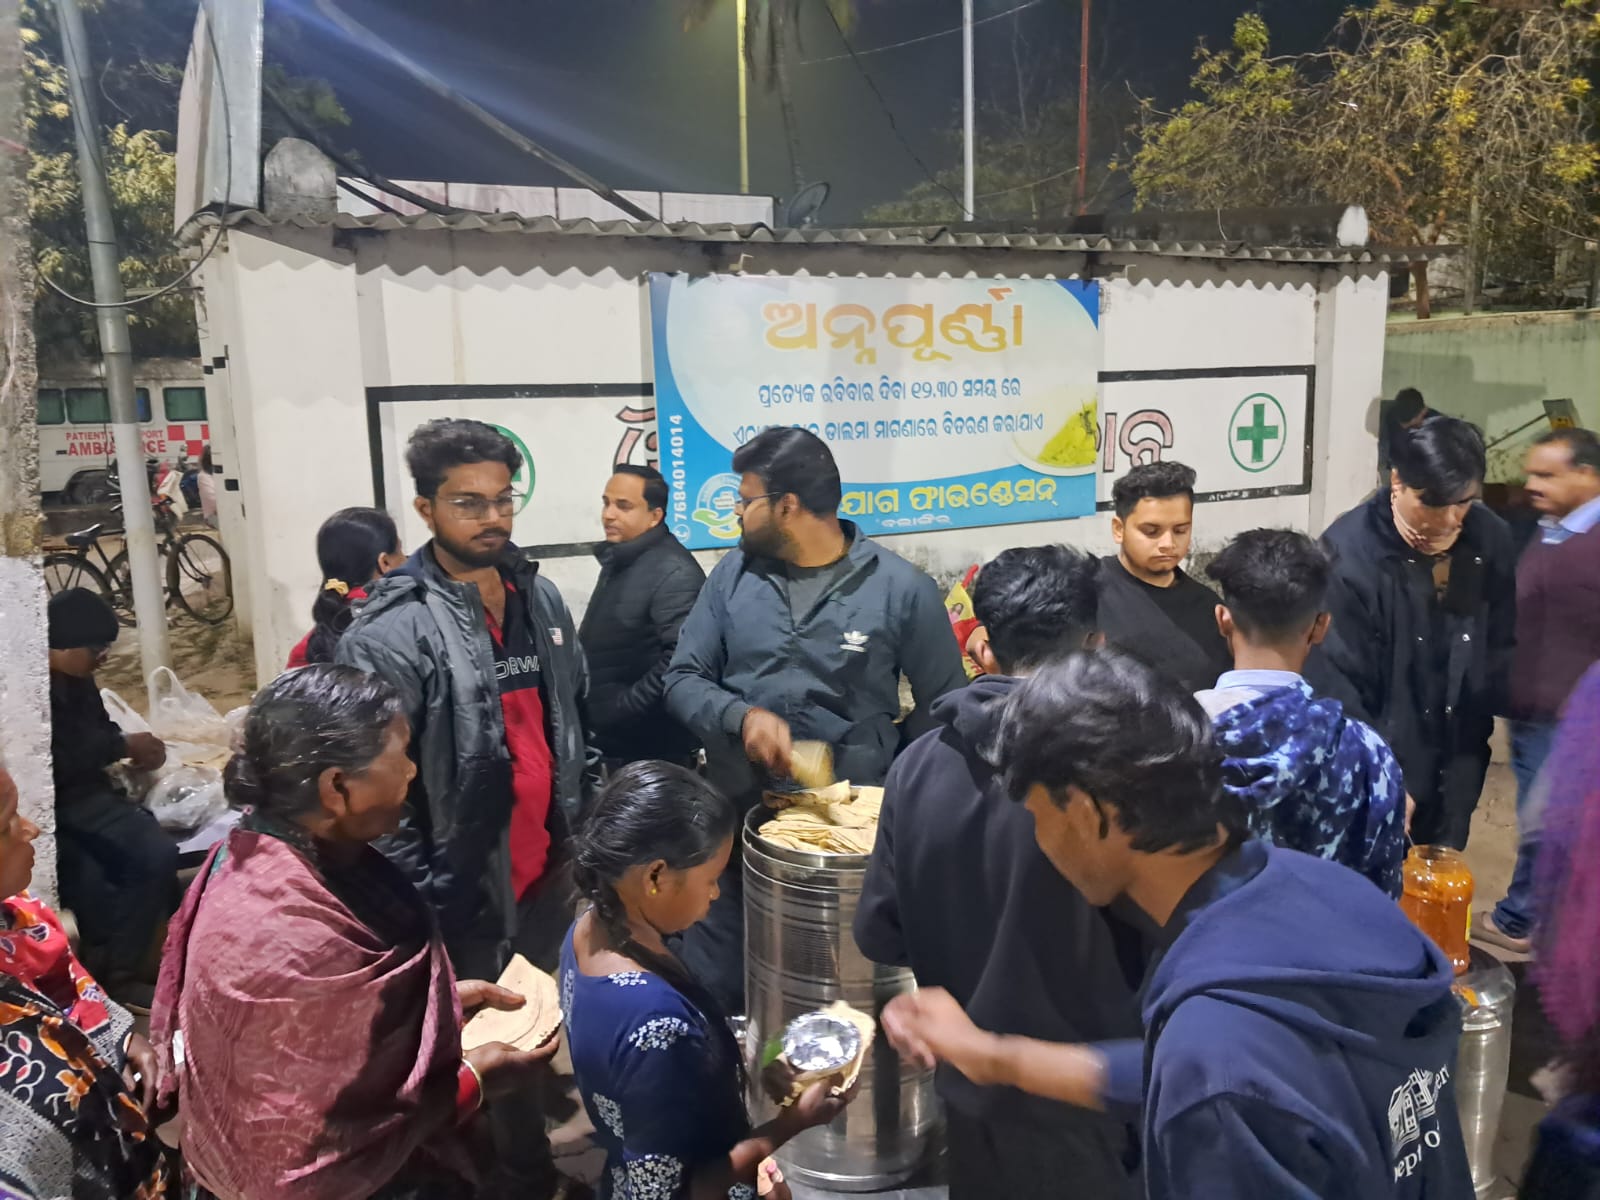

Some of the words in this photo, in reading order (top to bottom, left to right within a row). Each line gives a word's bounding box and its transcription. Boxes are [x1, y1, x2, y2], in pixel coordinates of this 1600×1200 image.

[763, 287, 1024, 365] ଅନ୍ନପୂର୍ଣ୍ଣା
[758, 383, 815, 408] ପ୍ରତ୍ୟେକ
[820, 376, 874, 402] ରବିବାର
[879, 375, 906, 400] ଦିବା
[911, 381, 958, 399] ୧୨.୩୦
[962, 378, 997, 398] ସମୟ
[1002, 377, 1021, 397] ରେ
[65, 432, 106, 441] PATIENT
[875, 418, 938, 439] ମାଗଣାରେ
[942, 410, 989, 434] ବିତରଣ
[992, 412, 1044, 433] କରାଯାଏ
[67, 439, 167, 456] AMBUCE
[669, 414, 687, 523] 7684014014
